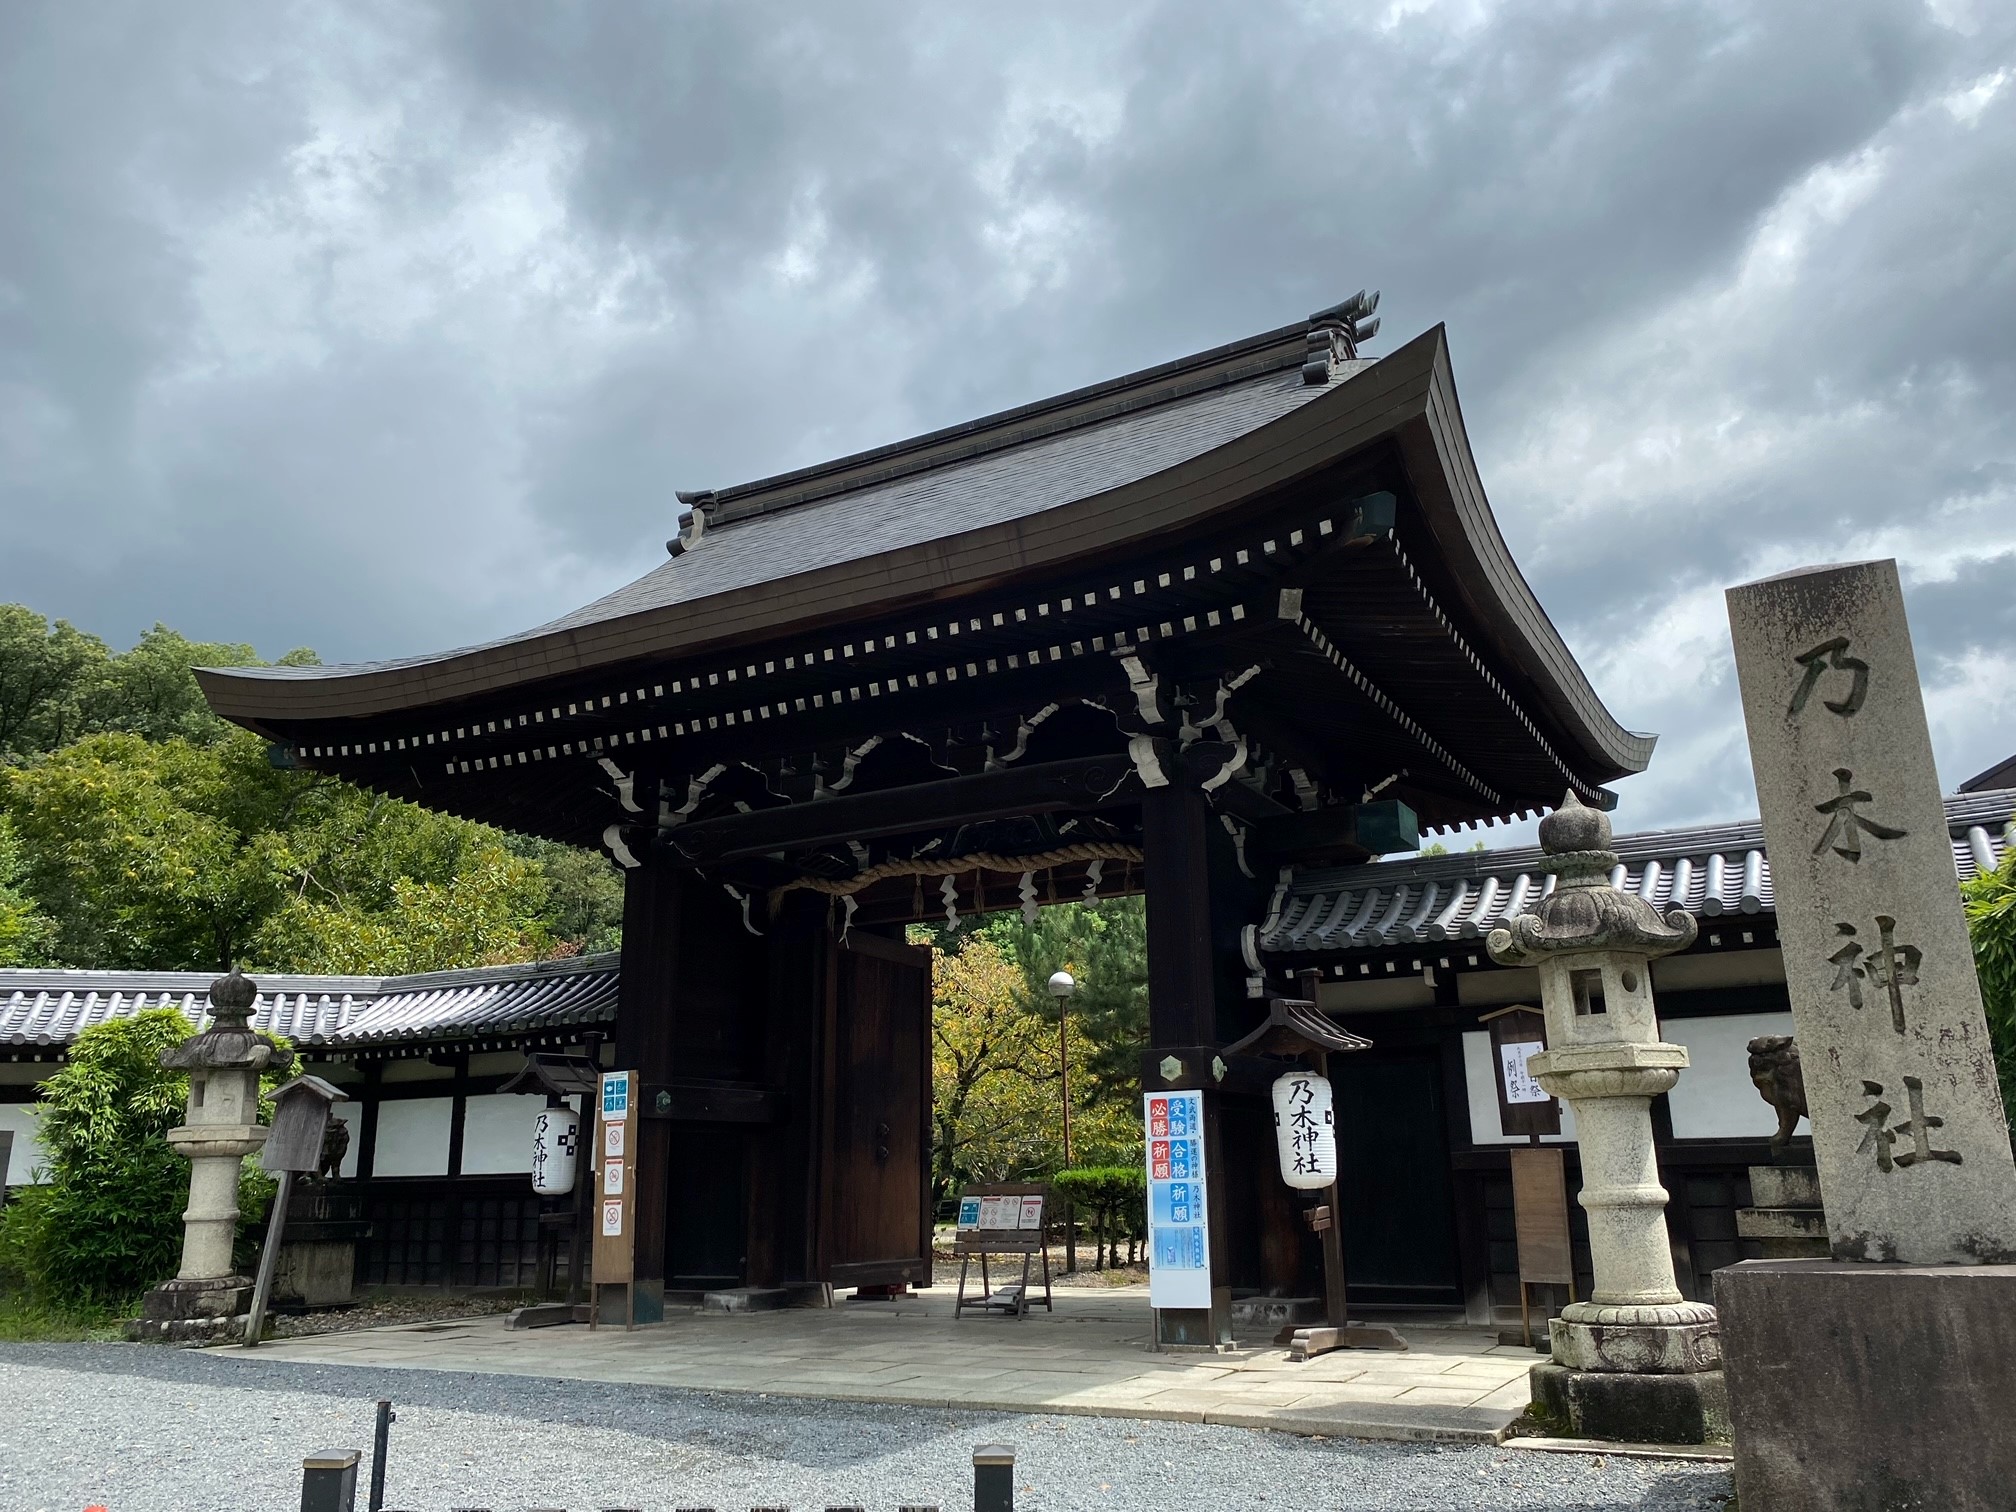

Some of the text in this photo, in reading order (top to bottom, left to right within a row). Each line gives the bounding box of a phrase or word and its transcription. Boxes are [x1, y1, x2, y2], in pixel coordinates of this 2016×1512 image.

[1788, 636, 1963, 1173] 乃木神社
[533, 1114, 549, 1188] 乃木神社
[1151, 1101, 1169, 1178] 必勝祈願
[1170, 1099, 1188, 1221] 受験合格祈願
[1288, 1079, 1322, 1175] 乃木神社
[1192, 1185, 1201, 1219] 乃木神社
